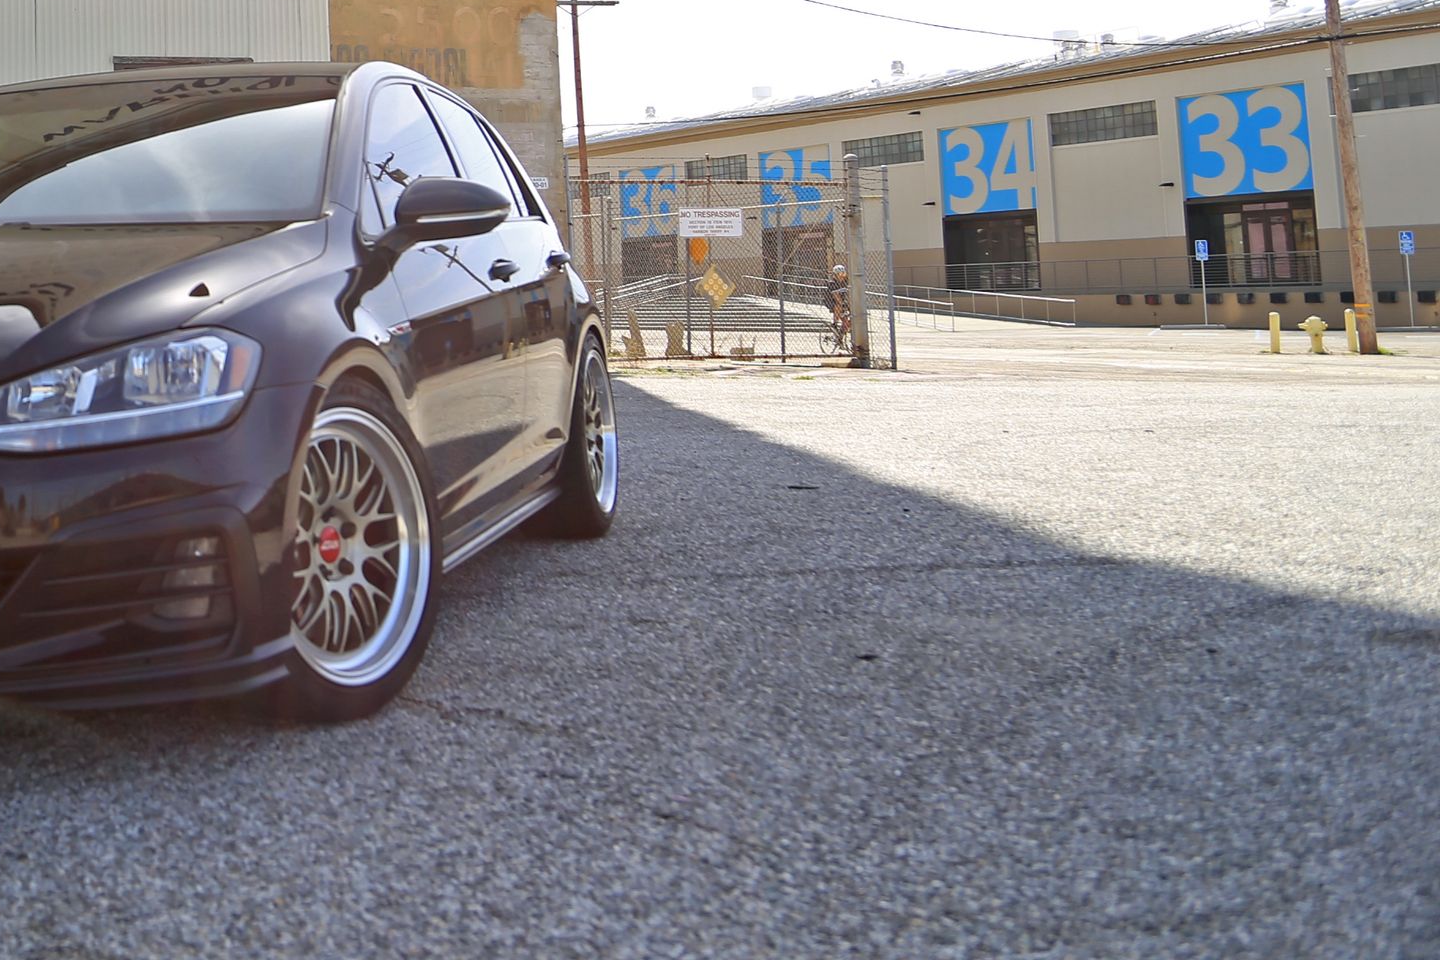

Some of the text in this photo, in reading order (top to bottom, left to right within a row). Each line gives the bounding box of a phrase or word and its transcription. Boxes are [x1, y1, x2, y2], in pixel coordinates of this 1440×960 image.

[765, 144, 833, 228] 35
[946, 119, 1037, 214] 34
[1186, 86, 1310, 197] 33
[624, 165, 677, 236] 36
